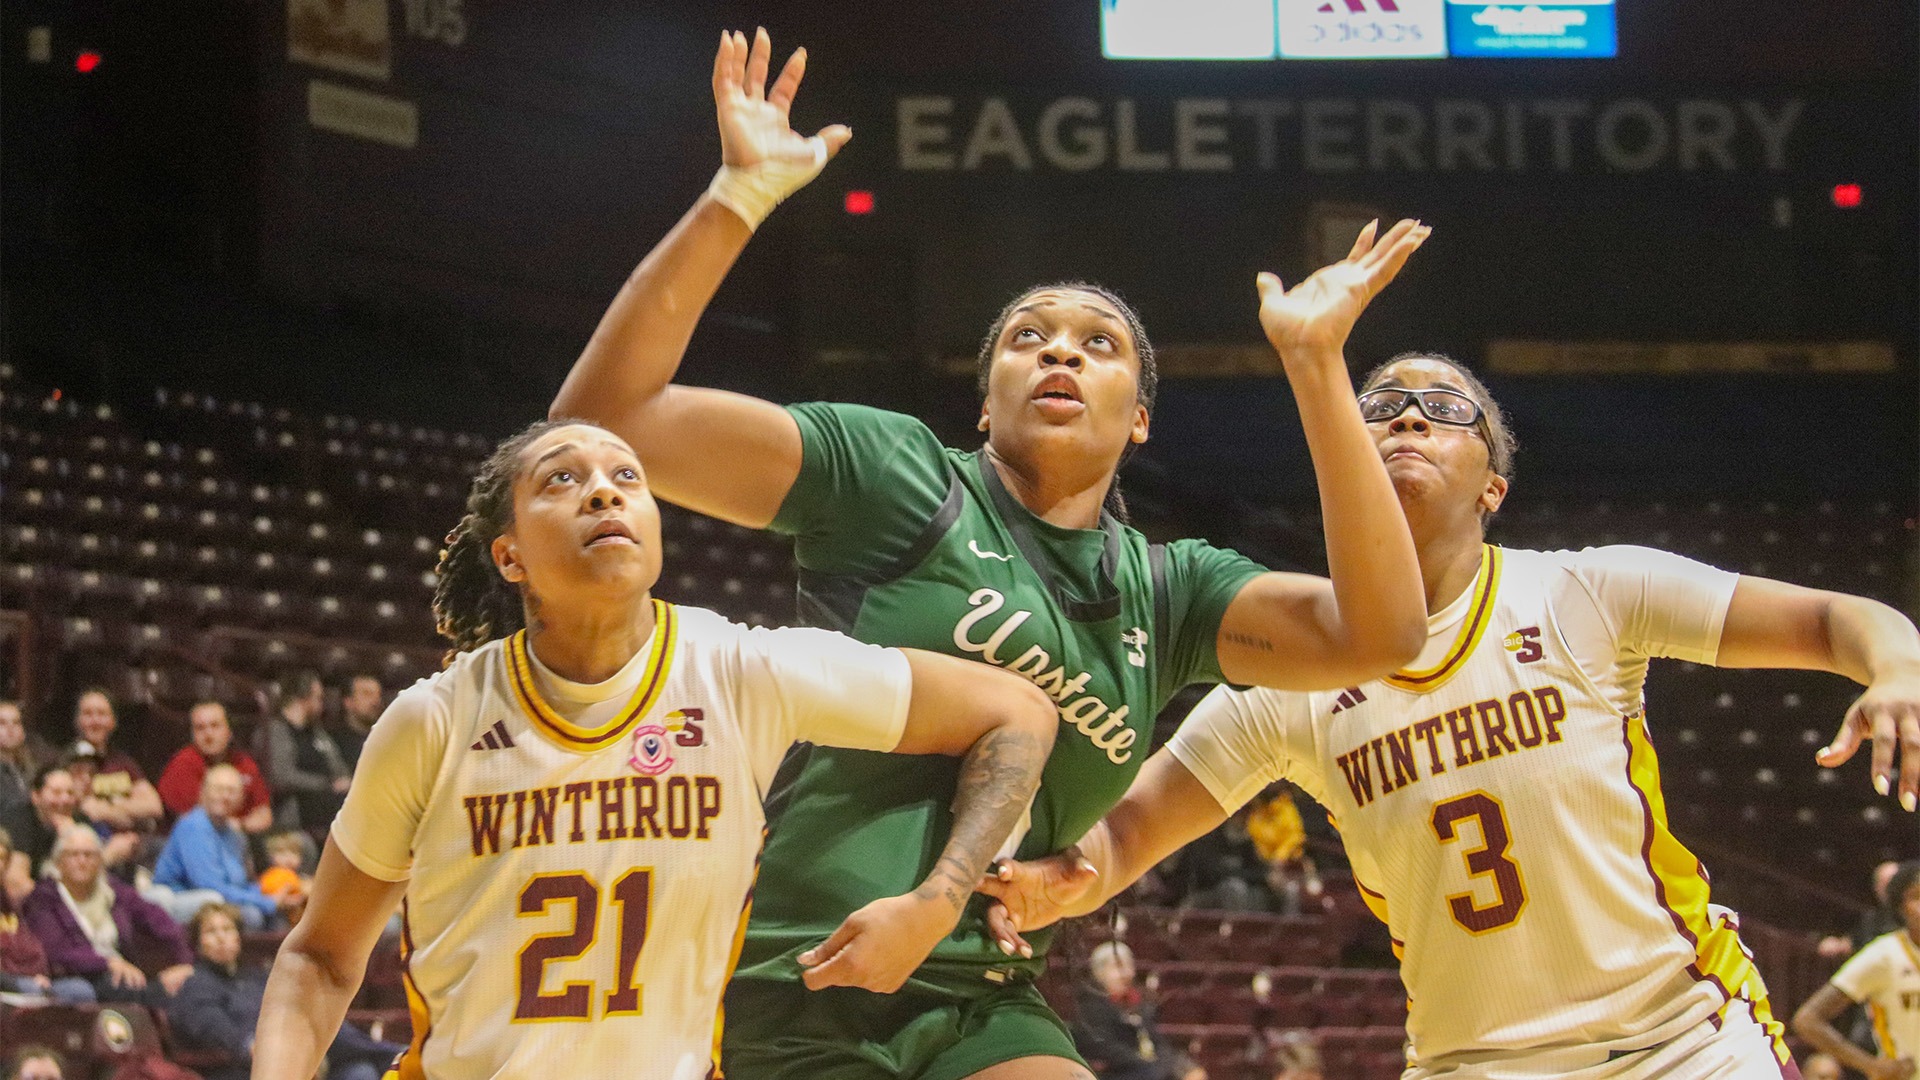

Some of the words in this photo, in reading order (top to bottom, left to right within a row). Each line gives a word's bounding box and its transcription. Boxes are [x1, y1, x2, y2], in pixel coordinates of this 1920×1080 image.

[953, 587, 1137, 766] Upstate
[1336, 685, 1567, 808] WINTHROP
[463, 775, 722, 857] WINTHROP
[1429, 788, 1530, 937] 3
[511, 866, 654, 1024] 21
